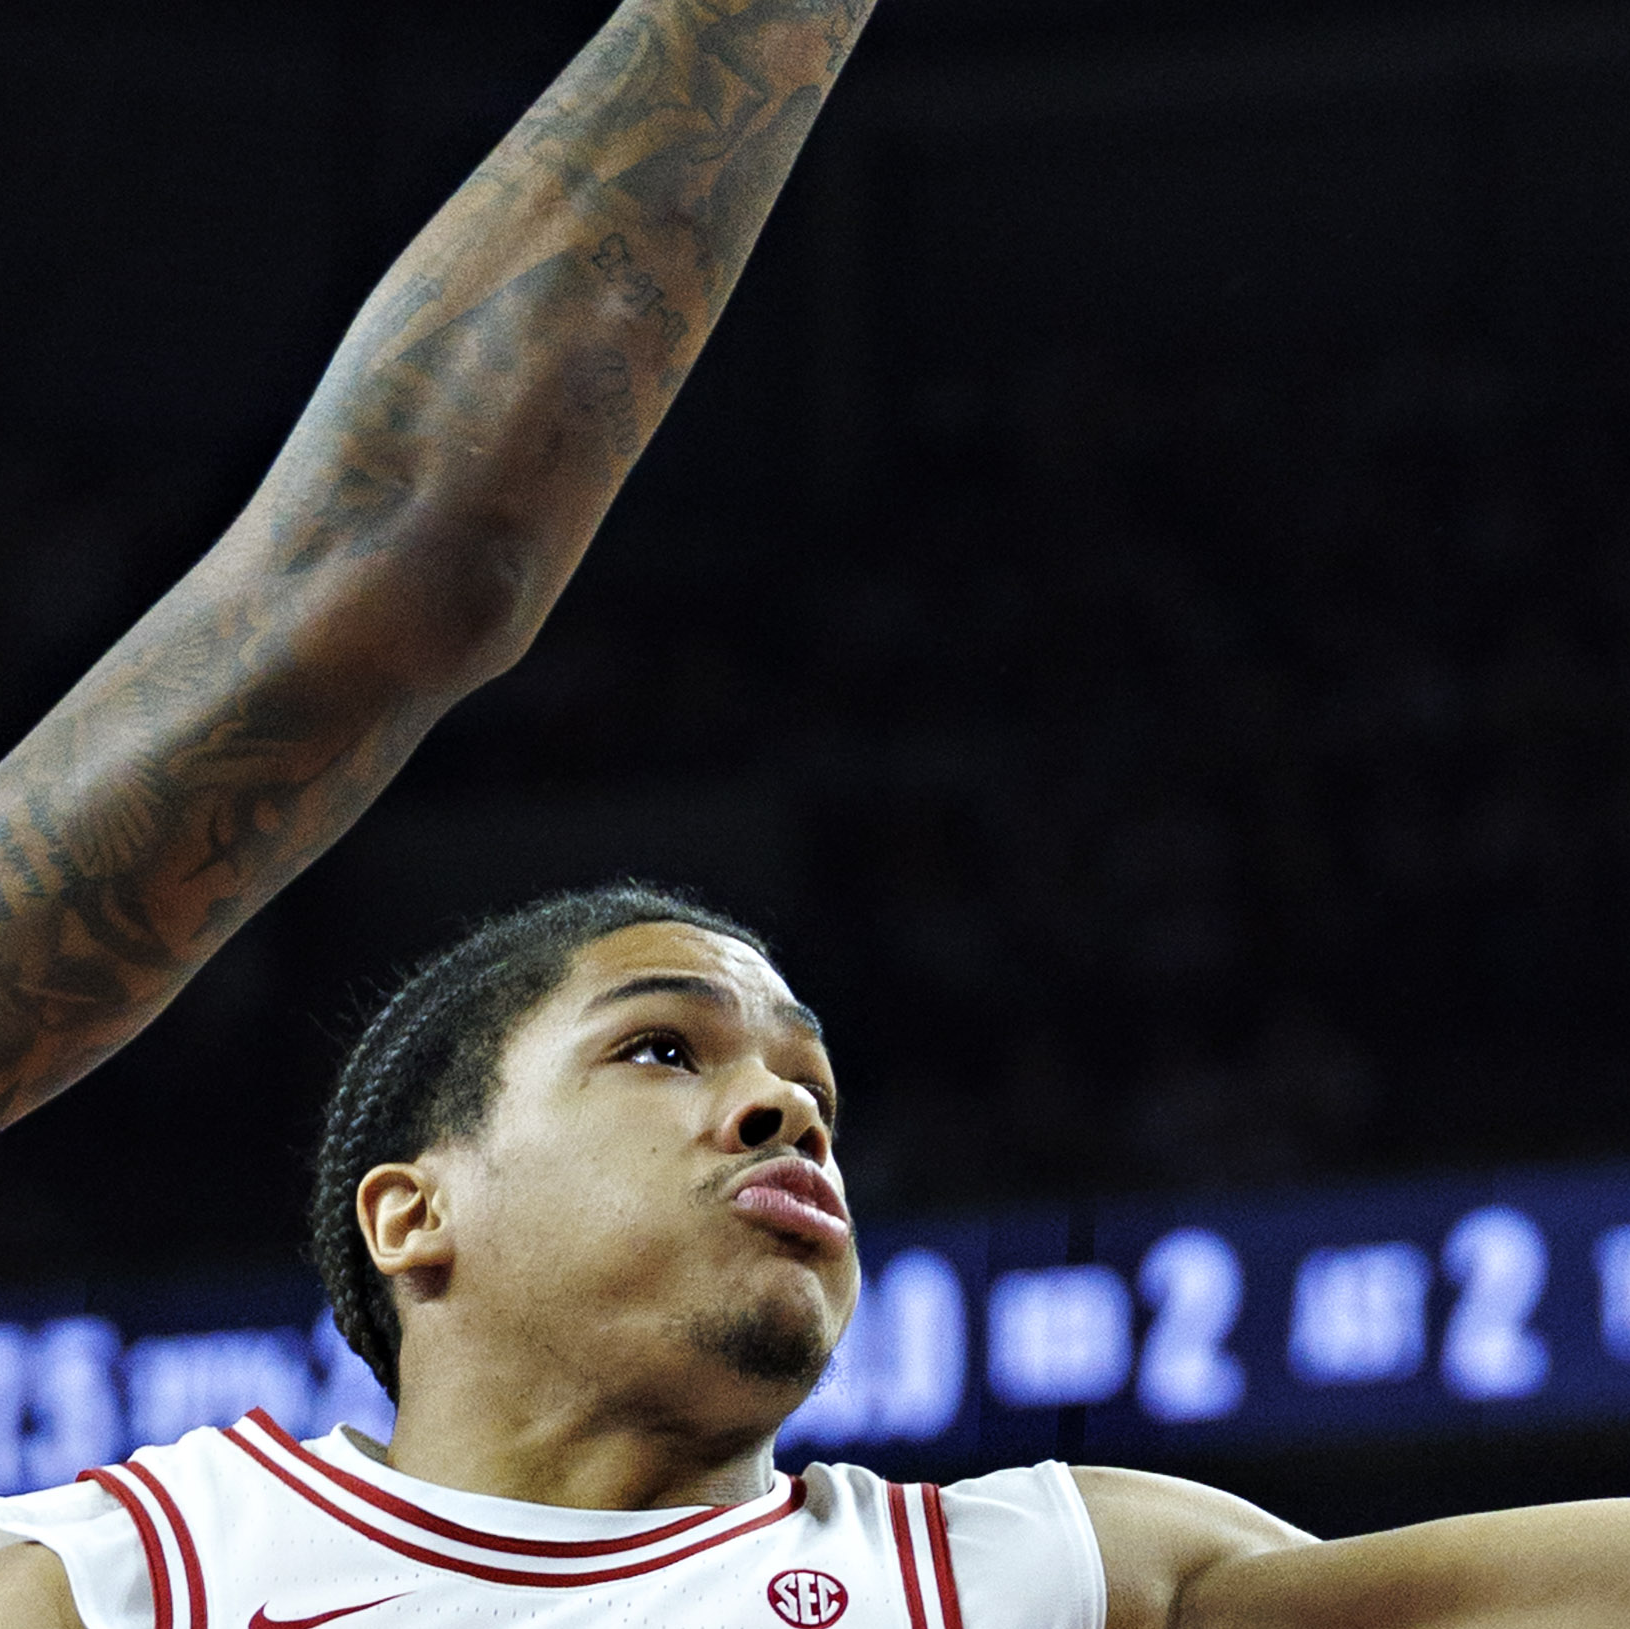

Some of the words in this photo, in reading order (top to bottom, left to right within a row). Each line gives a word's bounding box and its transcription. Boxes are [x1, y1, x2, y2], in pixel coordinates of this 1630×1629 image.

[1139, 1228, 1243, 1421] 2
[1441, 1206, 1548, 1398] 2
[772, 1572, 841, 1626] SEC
